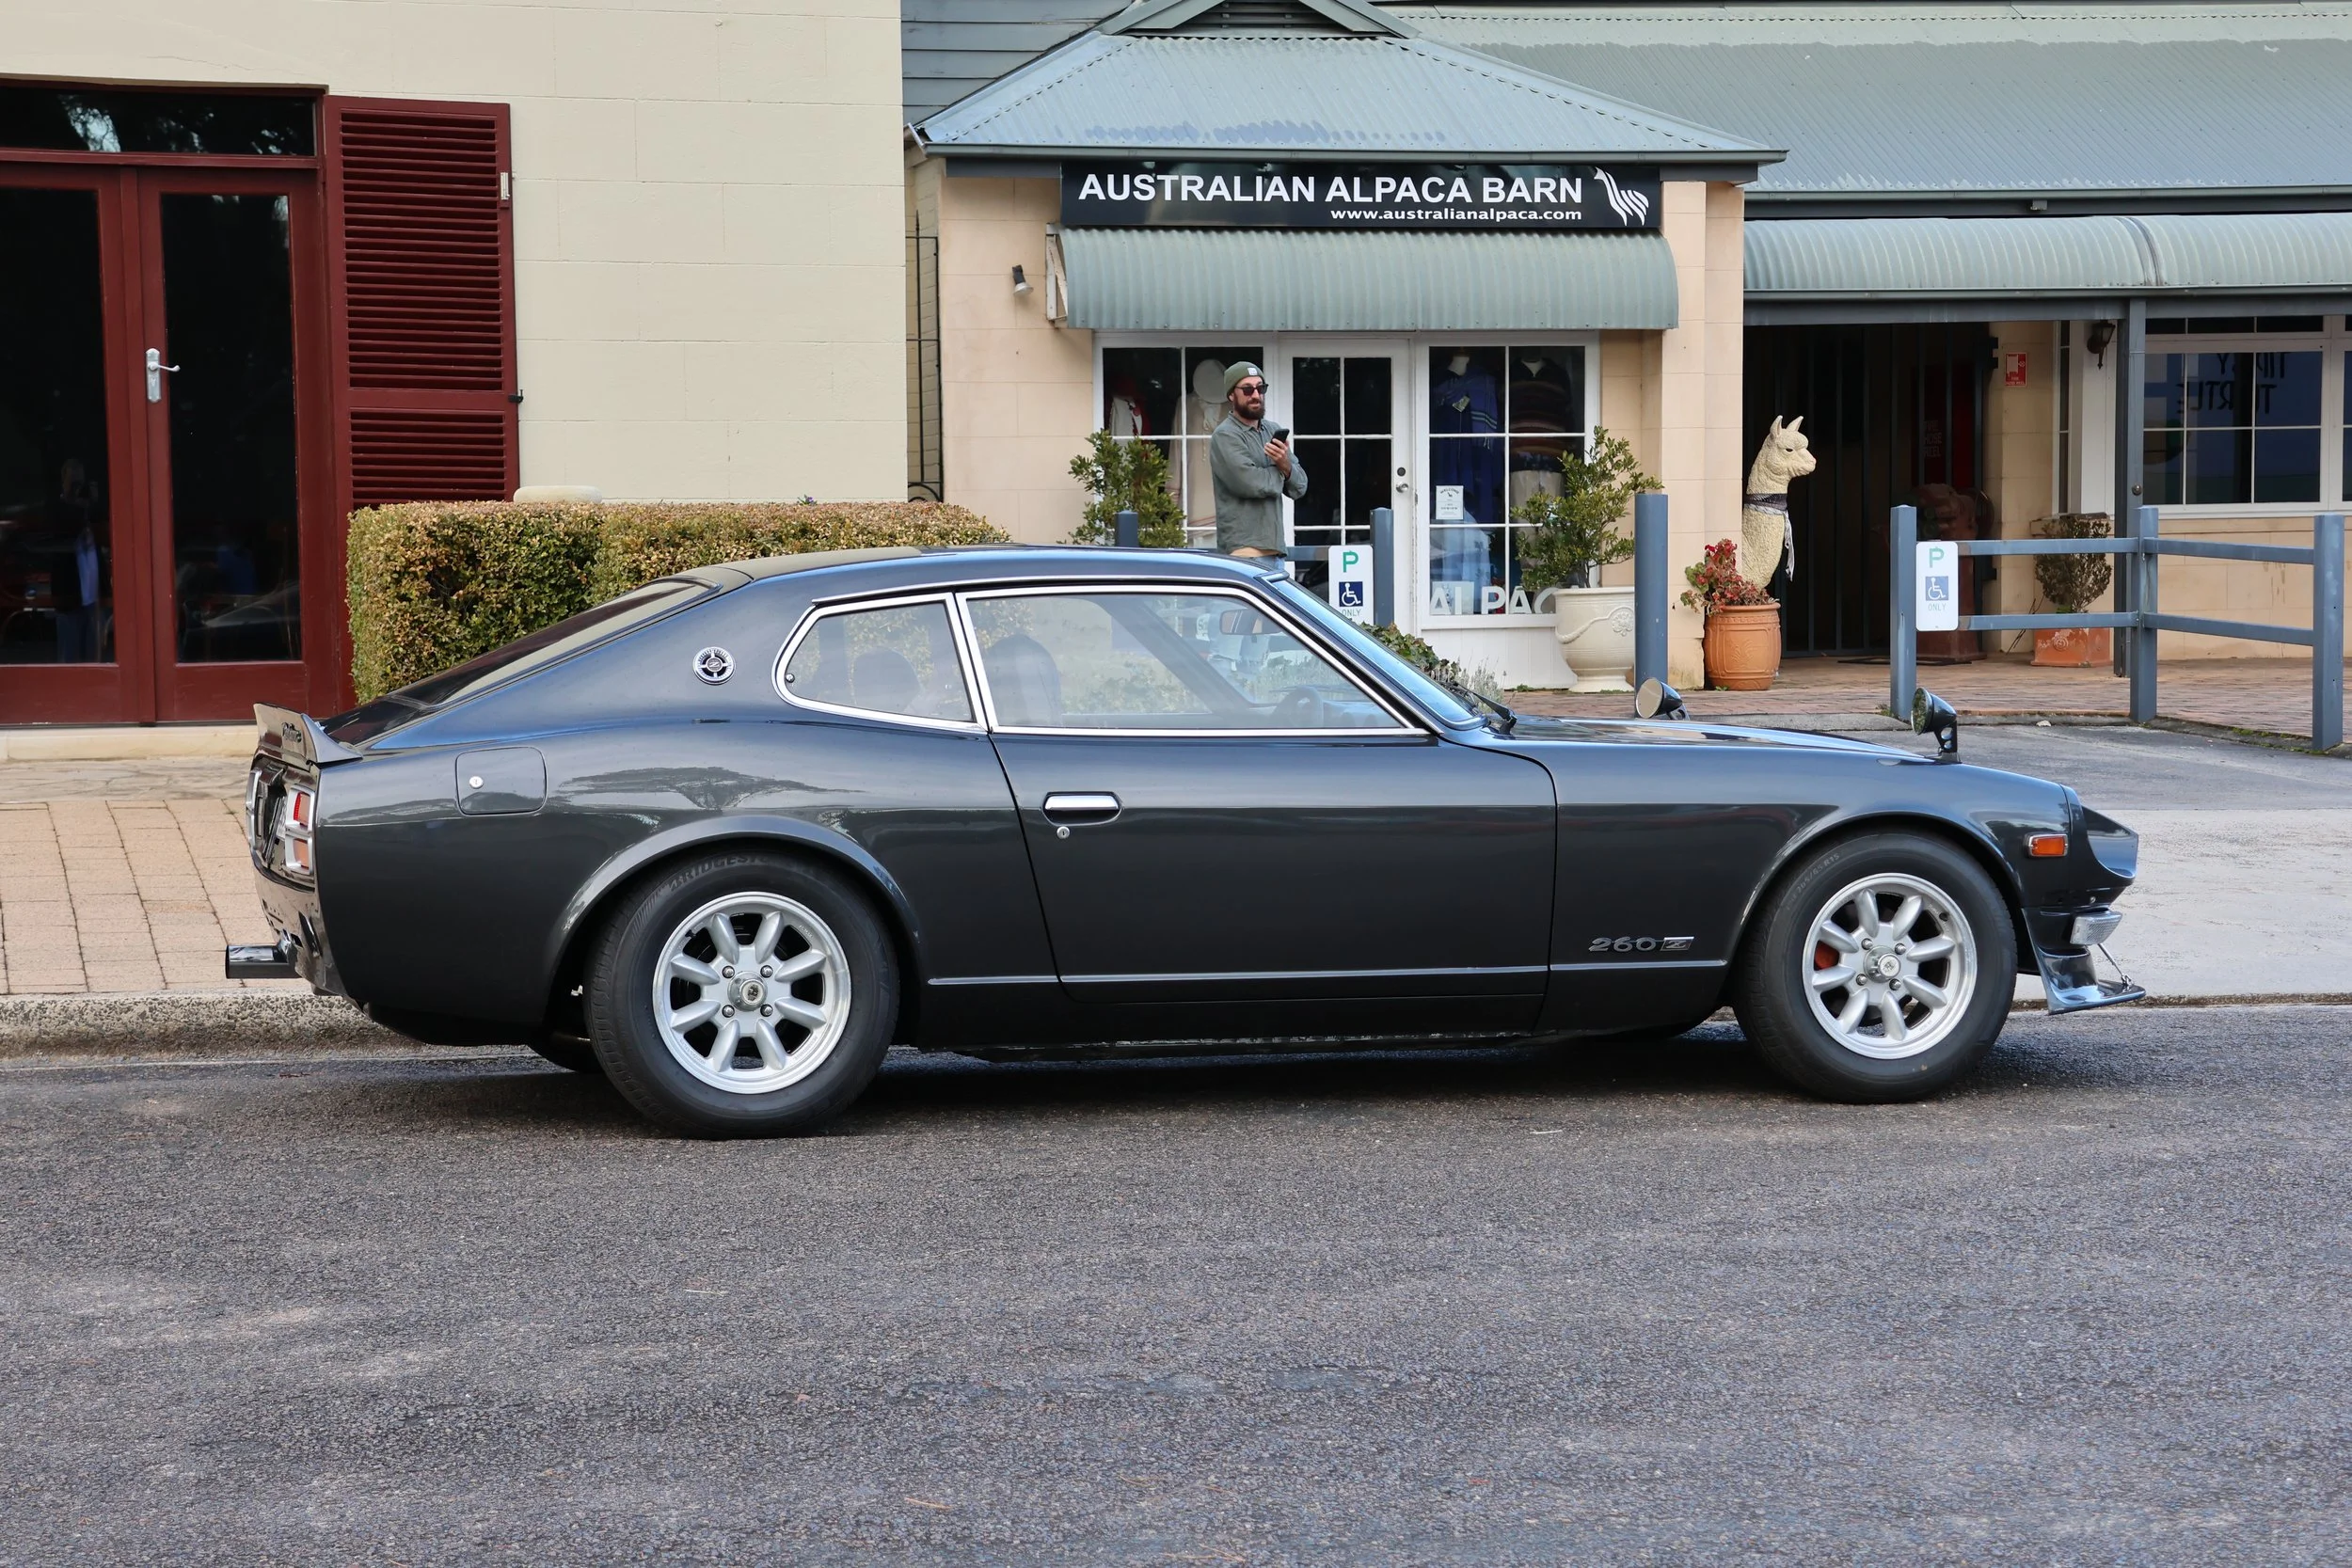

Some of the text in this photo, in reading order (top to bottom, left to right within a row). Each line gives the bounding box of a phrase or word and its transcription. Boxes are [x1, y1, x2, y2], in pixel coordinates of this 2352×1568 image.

[1078, 173, 1582, 203] AUSTRALIAN ALPACA BARN
[1330, 208, 1582, 222] www.australianalpaca.com
[1343, 551, 1359, 573] P
[1929, 547, 1945, 568] P
[1928, 603, 1947, 611] ONLY
